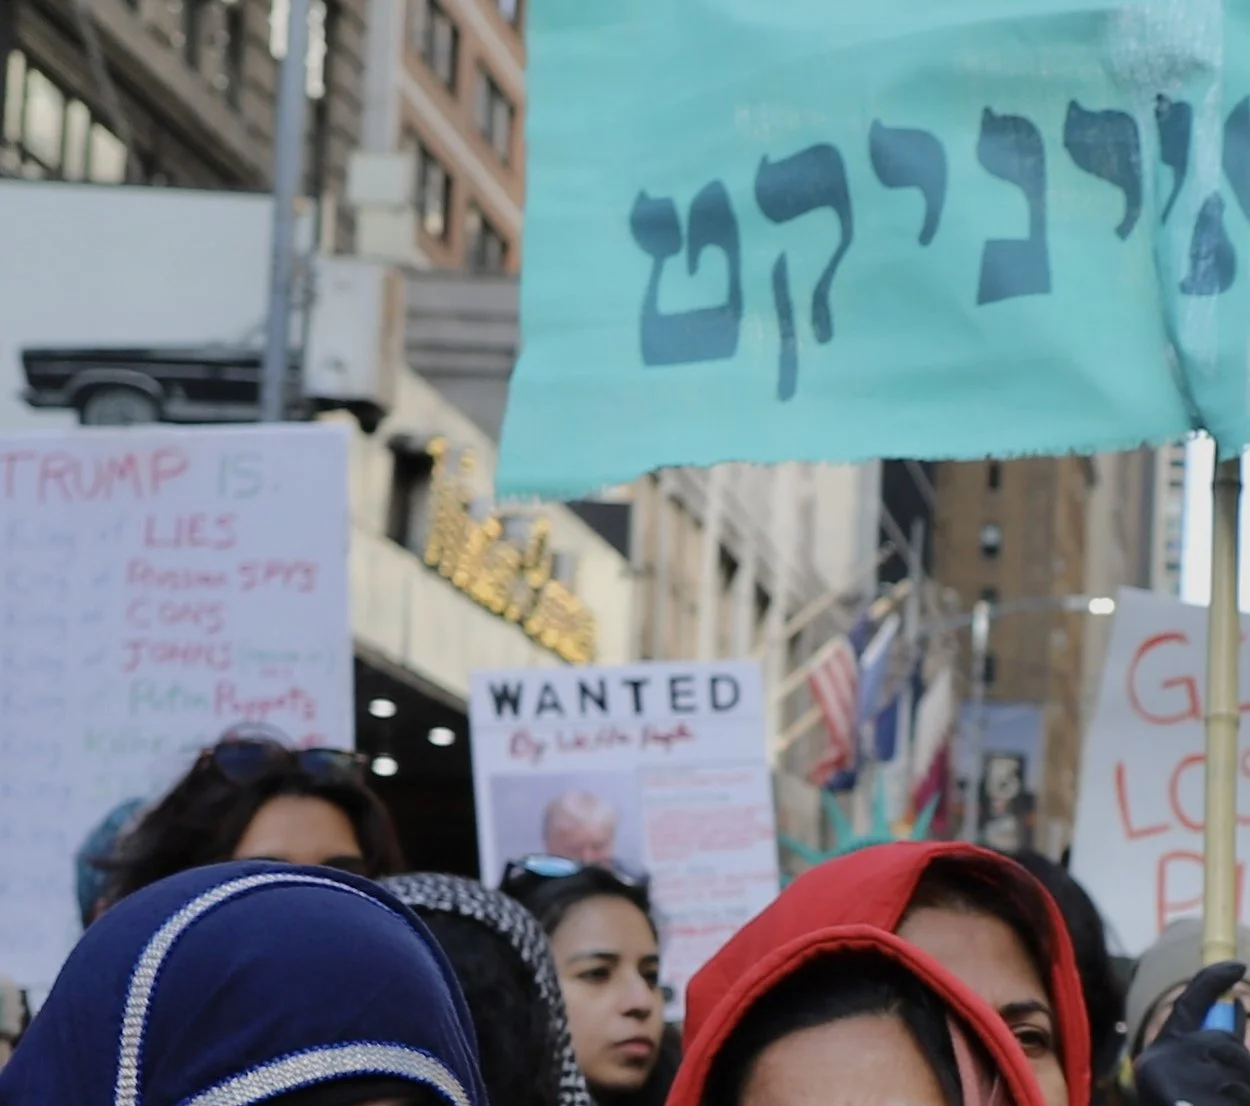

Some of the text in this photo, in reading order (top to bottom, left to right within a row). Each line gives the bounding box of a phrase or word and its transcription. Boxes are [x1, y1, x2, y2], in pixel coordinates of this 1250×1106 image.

[0, 446, 189, 503] TRUMP
[141, 512, 240, 550] LIES
[487, 673, 742, 720] WANTED
